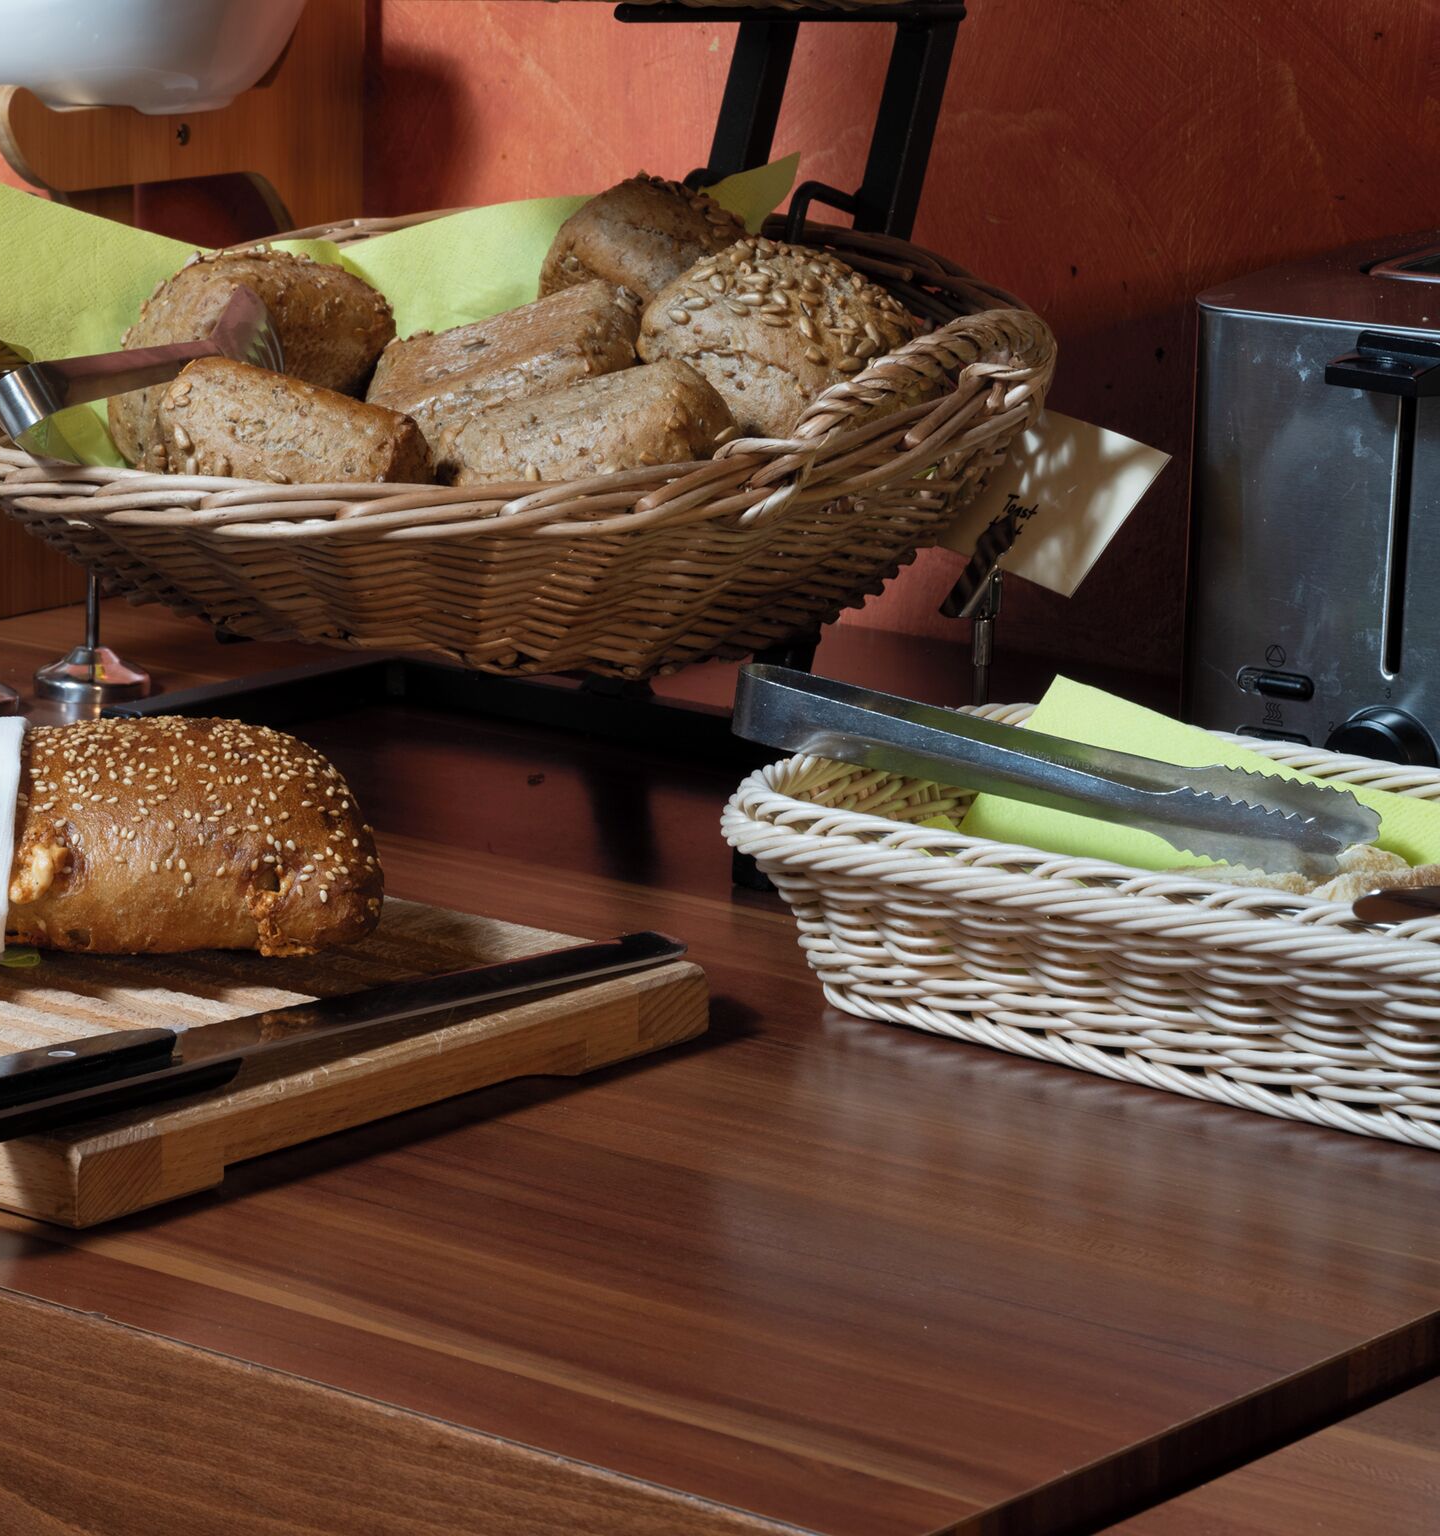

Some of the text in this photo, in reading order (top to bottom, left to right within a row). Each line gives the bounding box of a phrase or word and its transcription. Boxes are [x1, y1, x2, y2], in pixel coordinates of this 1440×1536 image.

[1002, 493, 1040, 521] Toast
[1384, 687, 1392, 700] 3
[1327, 721, 1335, 732] 2
